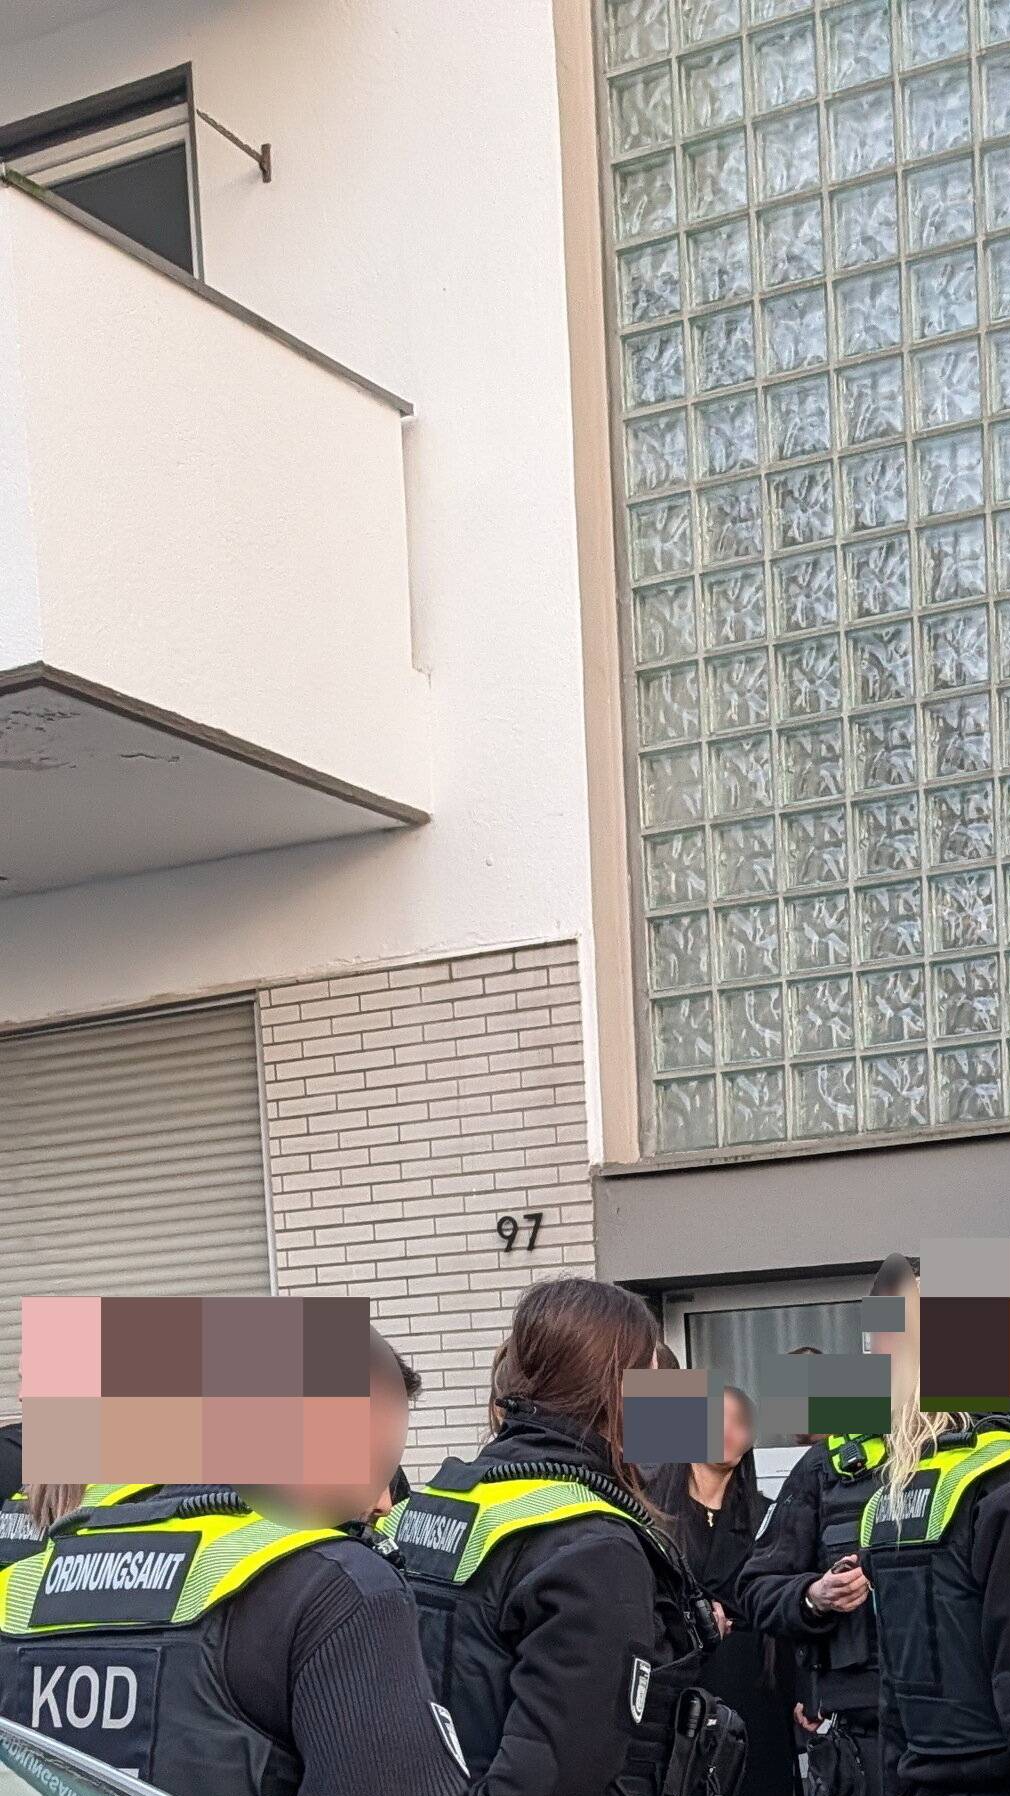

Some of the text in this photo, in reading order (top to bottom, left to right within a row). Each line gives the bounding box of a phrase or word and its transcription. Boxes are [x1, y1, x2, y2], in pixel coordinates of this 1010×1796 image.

[497, 1212, 543, 1253] 97
[45, 1551, 186, 1595] ORDNUNGSAMT
[31, 1665, 138, 1730] KOD
